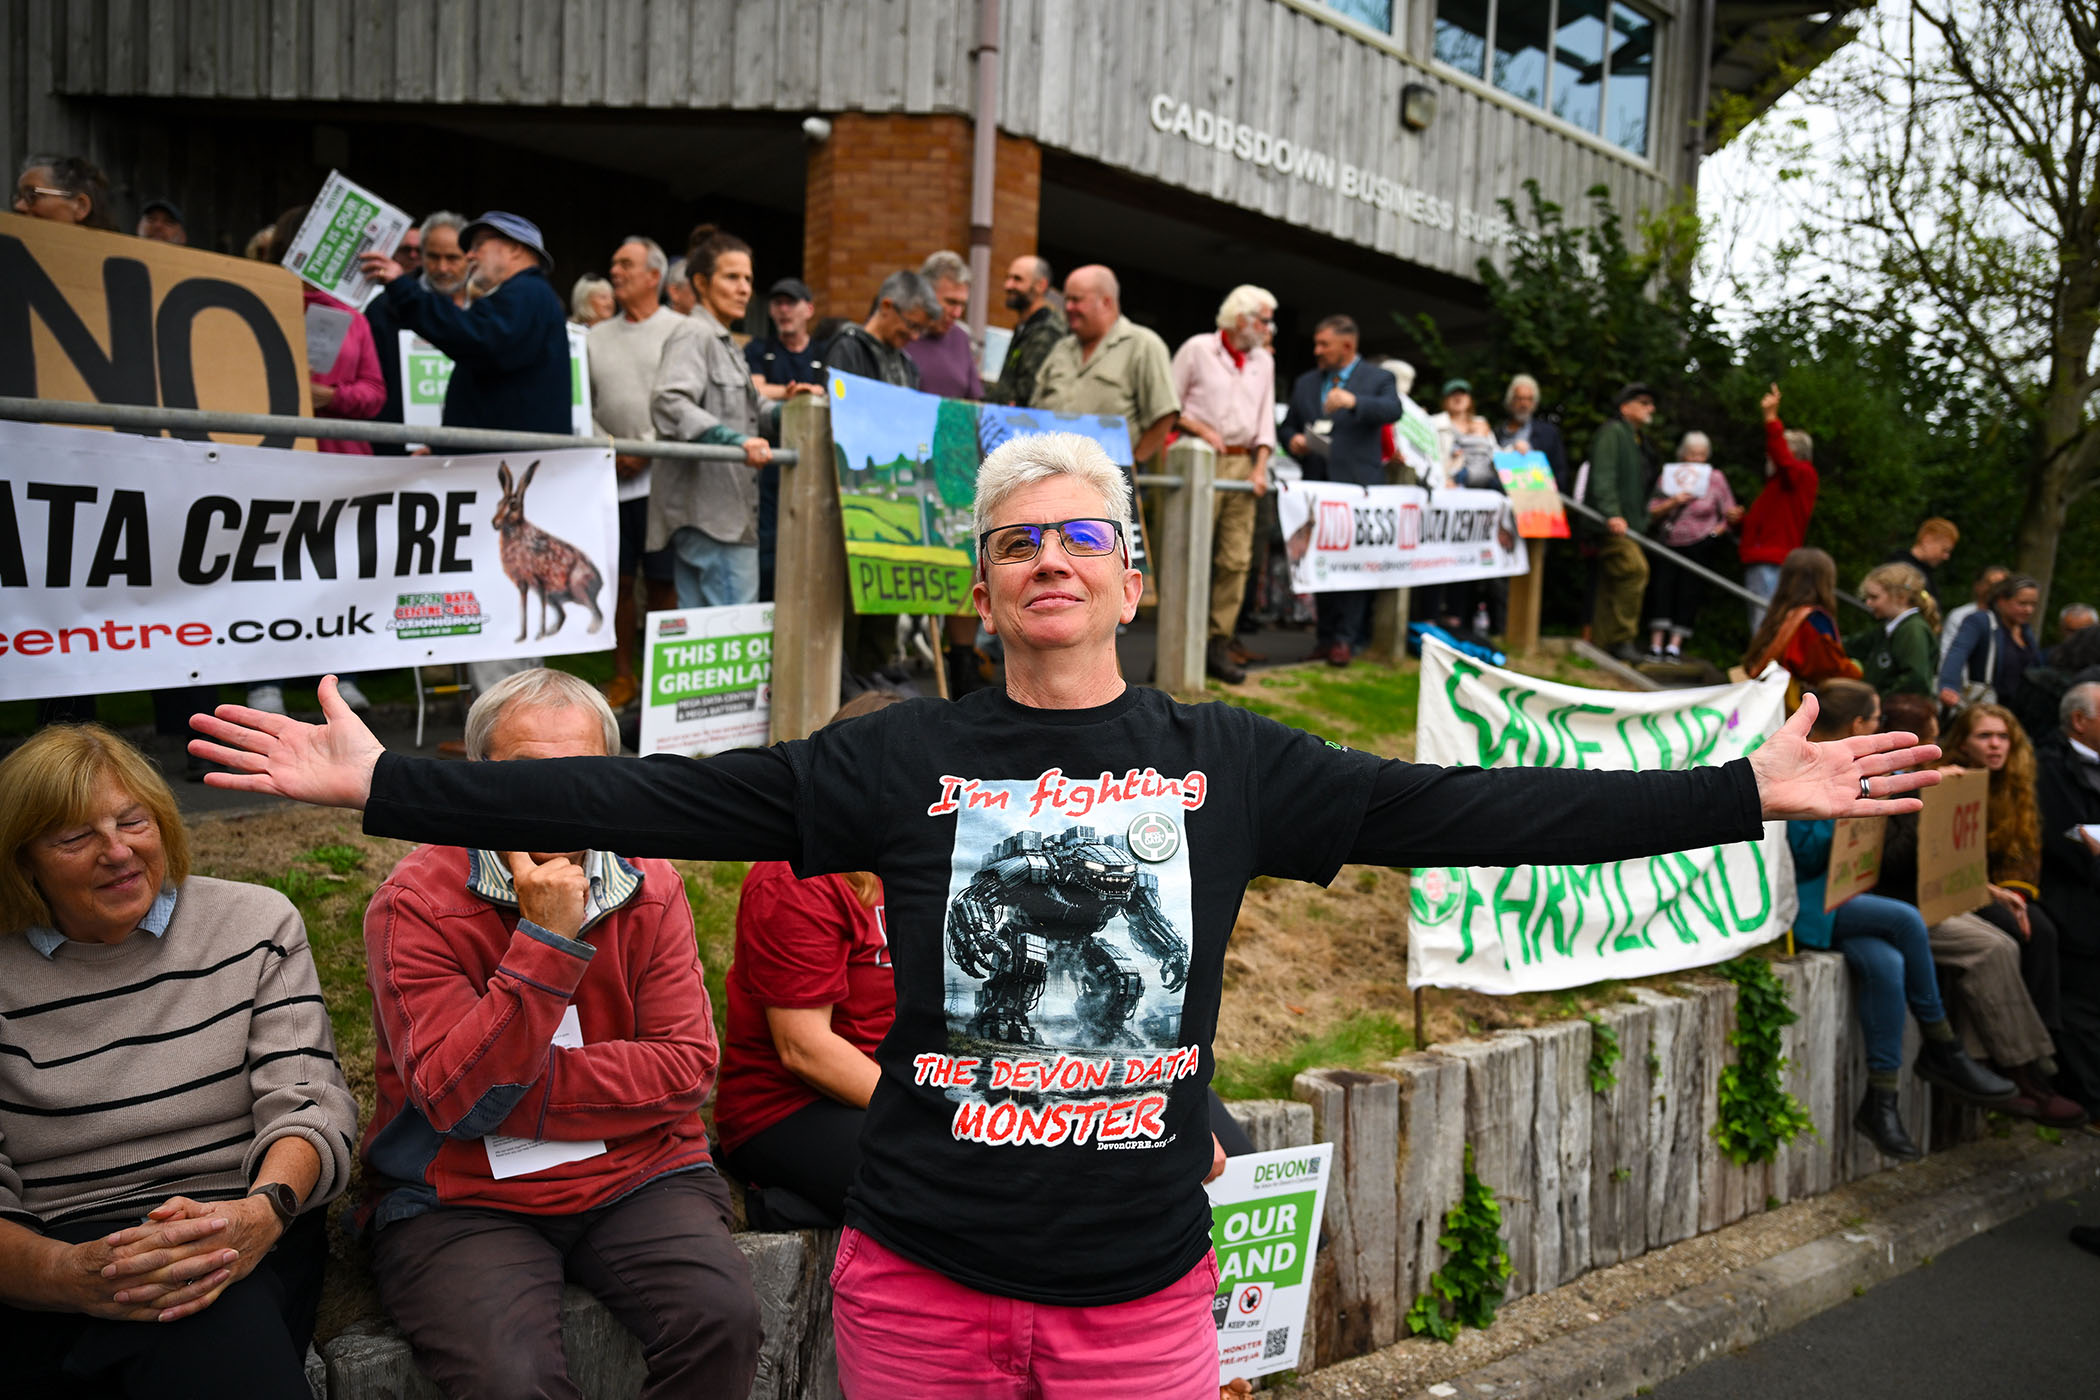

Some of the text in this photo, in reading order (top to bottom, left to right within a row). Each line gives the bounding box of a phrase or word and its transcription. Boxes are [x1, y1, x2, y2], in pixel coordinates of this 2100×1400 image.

[1151, 94, 1336, 189] CADDSDOWN
[1341, 164, 1453, 231] BUSINESS
[333, 197, 359, 230] OUR
[0, 232, 300, 450] NO
[178, 491, 477, 585] CENTRE
[1317, 501, 1350, 551] NO
[1354, 508, 1396, 546] BESS
[859, 561, 961, 604] PLEASE
[0, 606, 375, 657] entre.co.uk
[662, 639, 775, 669] THIS IS OU
[1446, 660, 1725, 771] SAVE OUR
[927, 766, 1207, 820] I'm fighting
[1952, 801, 1981, 849] OFF
[1457, 840, 1770, 970] FARMLAND
[913, 1046, 1199, 1091] THE DEVON DATA
[953, 1094, 1167, 1145] MONSTER
[1254, 1159, 1308, 1183] DEVON
[1223, 1203, 1298, 1242] OUR
[1220, 1241, 1297, 1283] AND
[1220, 1352, 1260, 1366] PRE.org.uk
[1223, 1339, 1262, 1354] MONSTER
